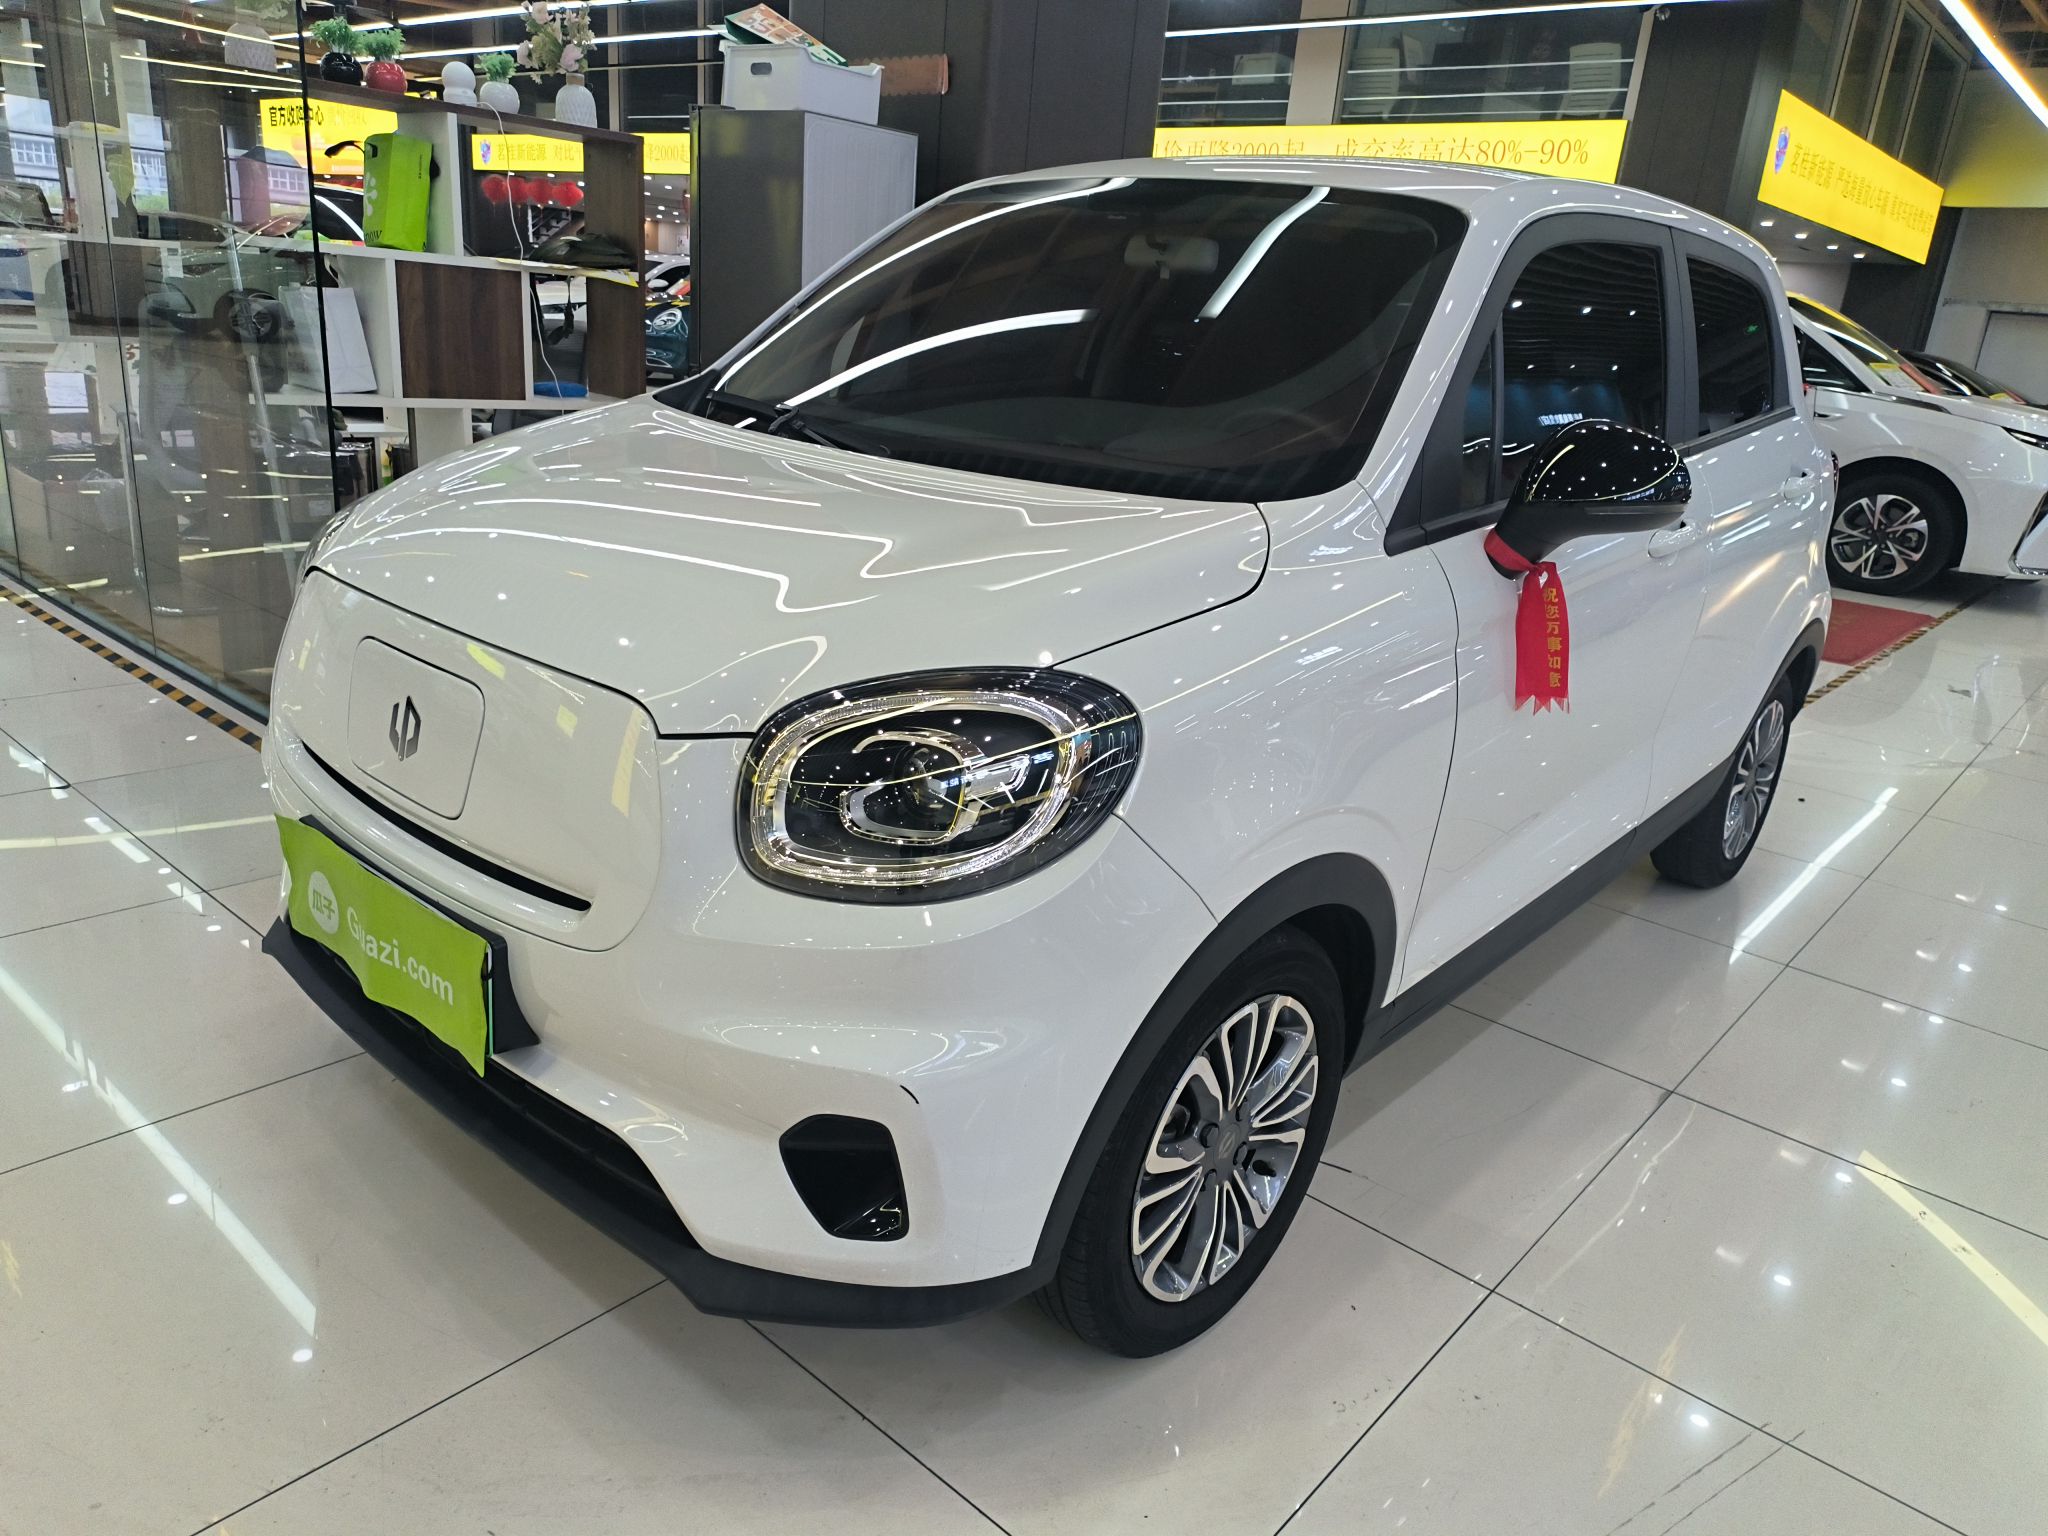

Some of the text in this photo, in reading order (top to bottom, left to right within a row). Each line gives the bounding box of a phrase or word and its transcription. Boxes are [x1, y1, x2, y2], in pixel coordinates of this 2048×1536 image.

[269, 104, 325, 127] 官方收购中心
[1154, 136, 1589, 165] 价再降2000起 成交率高达80%-90%
[312, 889, 336, 921] 瓜子
[346, 906, 454, 1006] Guazi.com
